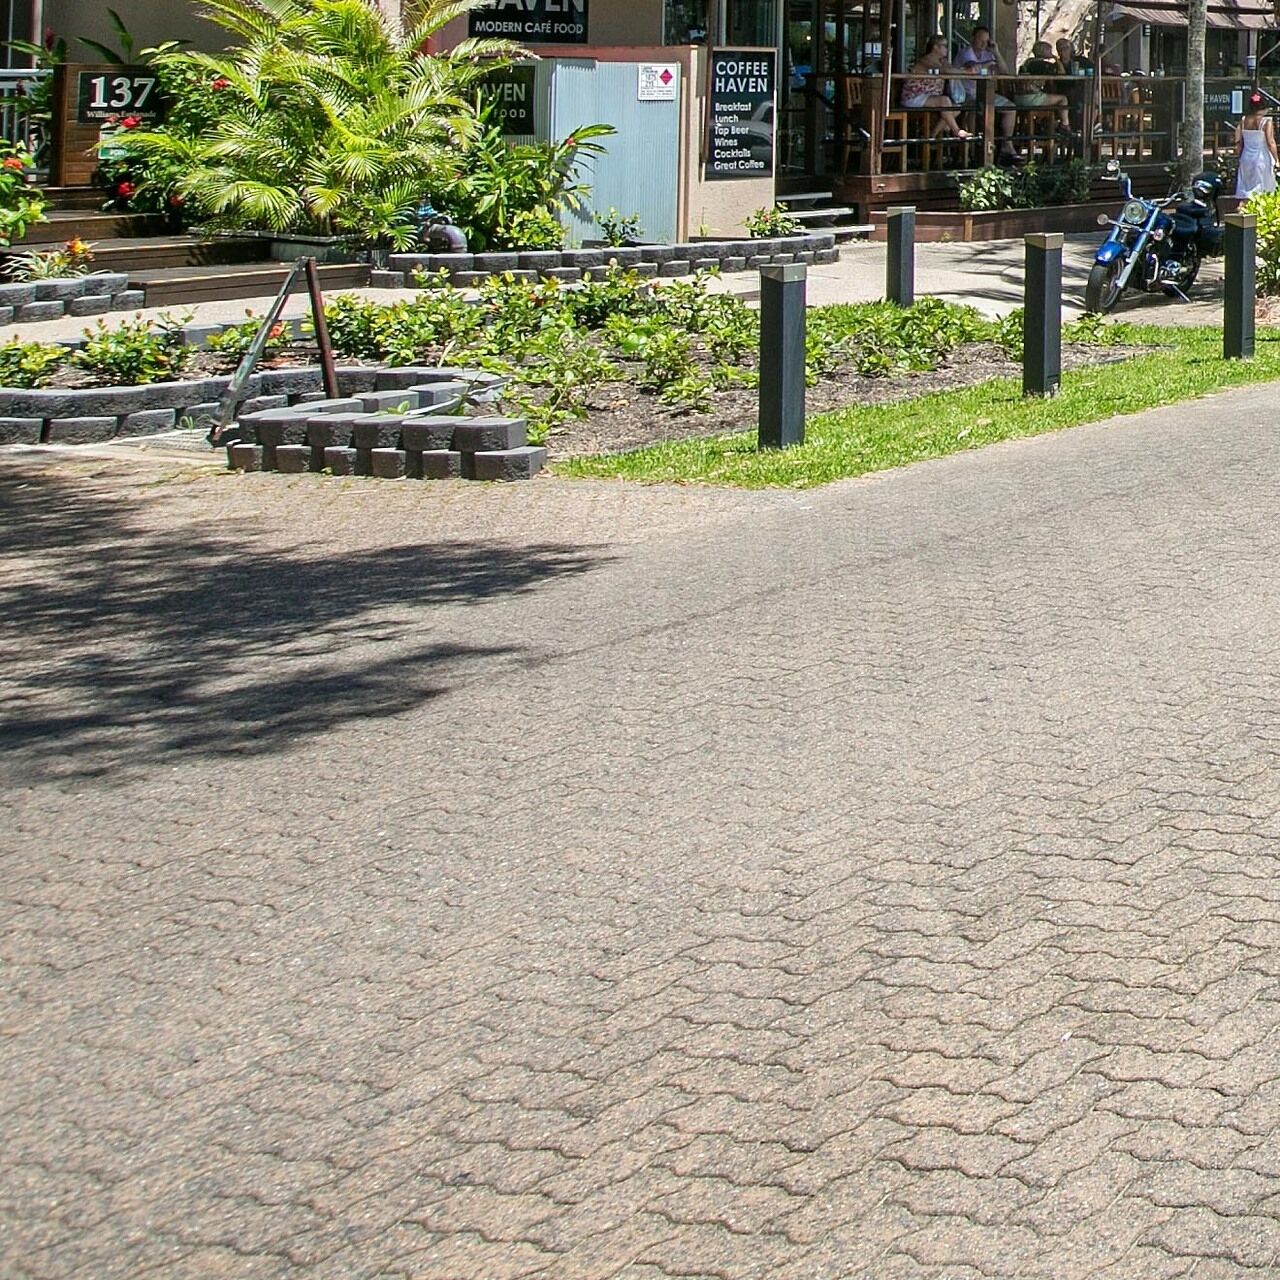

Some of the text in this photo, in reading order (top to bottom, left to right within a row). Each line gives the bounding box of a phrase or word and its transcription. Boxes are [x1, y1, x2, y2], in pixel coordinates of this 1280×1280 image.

[475, 20, 584, 34] MODERN CAFÉ FOOD
[716, 61, 768, 76] COFFEE
[715, 77, 768, 93] HAVEN
[90, 76, 156, 108] 137
[714, 102, 752, 112] Breakfast
[715, 114, 739, 123] Lunch
[714, 125, 749, 136] Tap Beer
[714, 137, 738, 146] Wines
[714, 148, 751, 158] Cocktails
[714, 159, 765, 170] Great Coffee
